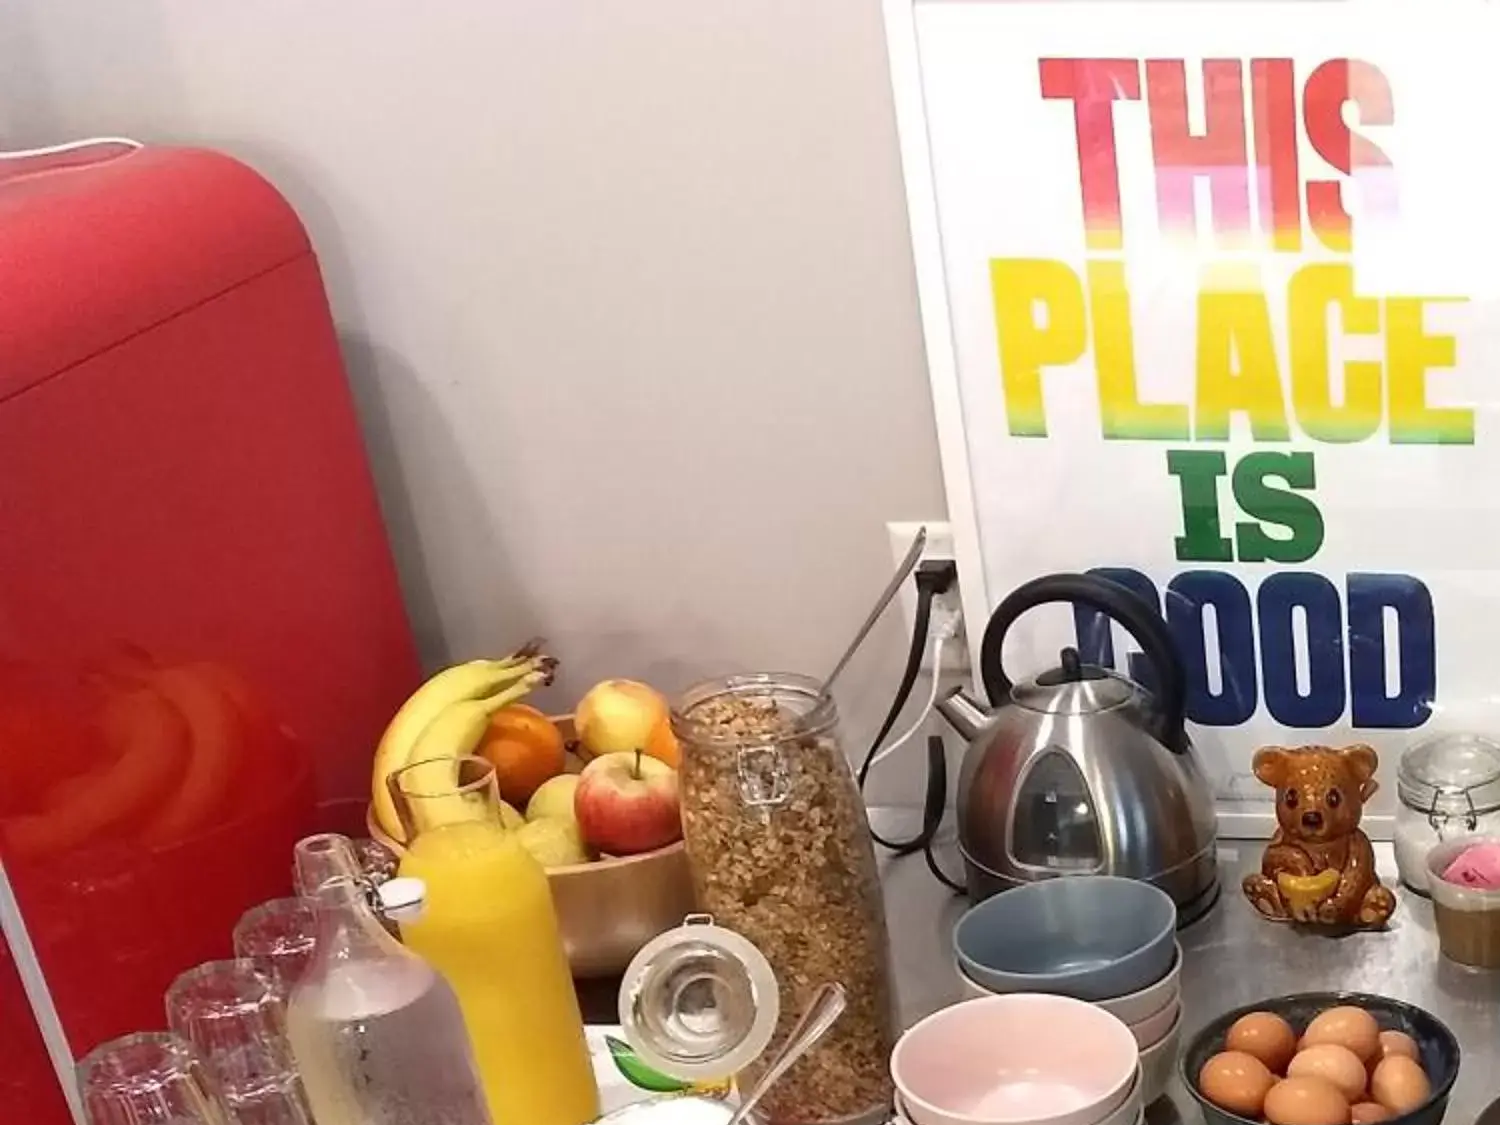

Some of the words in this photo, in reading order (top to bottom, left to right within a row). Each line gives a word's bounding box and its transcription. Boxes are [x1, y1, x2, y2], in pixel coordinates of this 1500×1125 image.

[1038, 57, 1398, 252] THIS
[990, 257, 1475, 445] PLACE
[1167, 450, 1325, 563] IS
